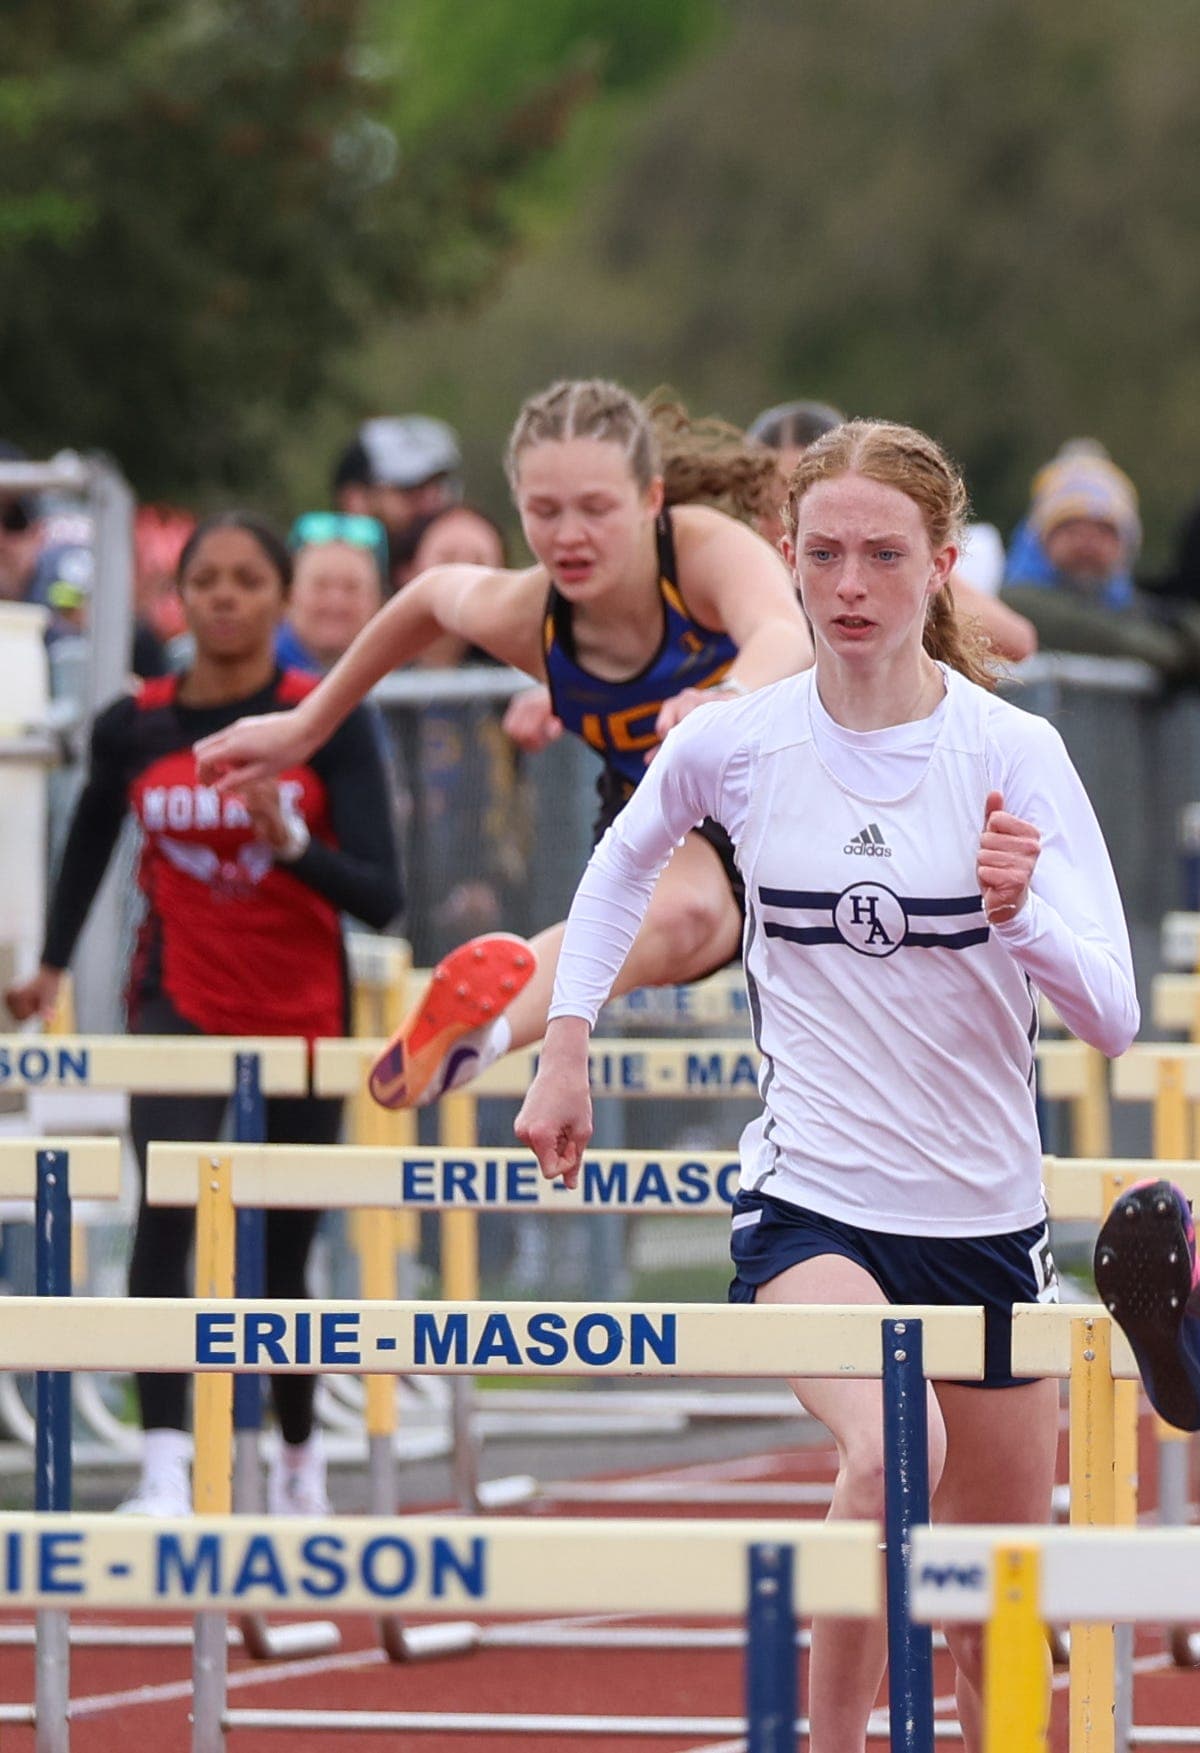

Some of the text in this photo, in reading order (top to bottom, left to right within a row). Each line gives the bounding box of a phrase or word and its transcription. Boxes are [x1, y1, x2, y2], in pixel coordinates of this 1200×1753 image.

[843, 843, 892, 858] adidas
[402, 1161, 538, 1203] ERIE
[584, 1162, 741, 1205] MASO
[195, 1312, 361, 1365] ERIE
[413, 1312, 676, 1366] MASON
[155, 1534, 487, 1599] MASON
